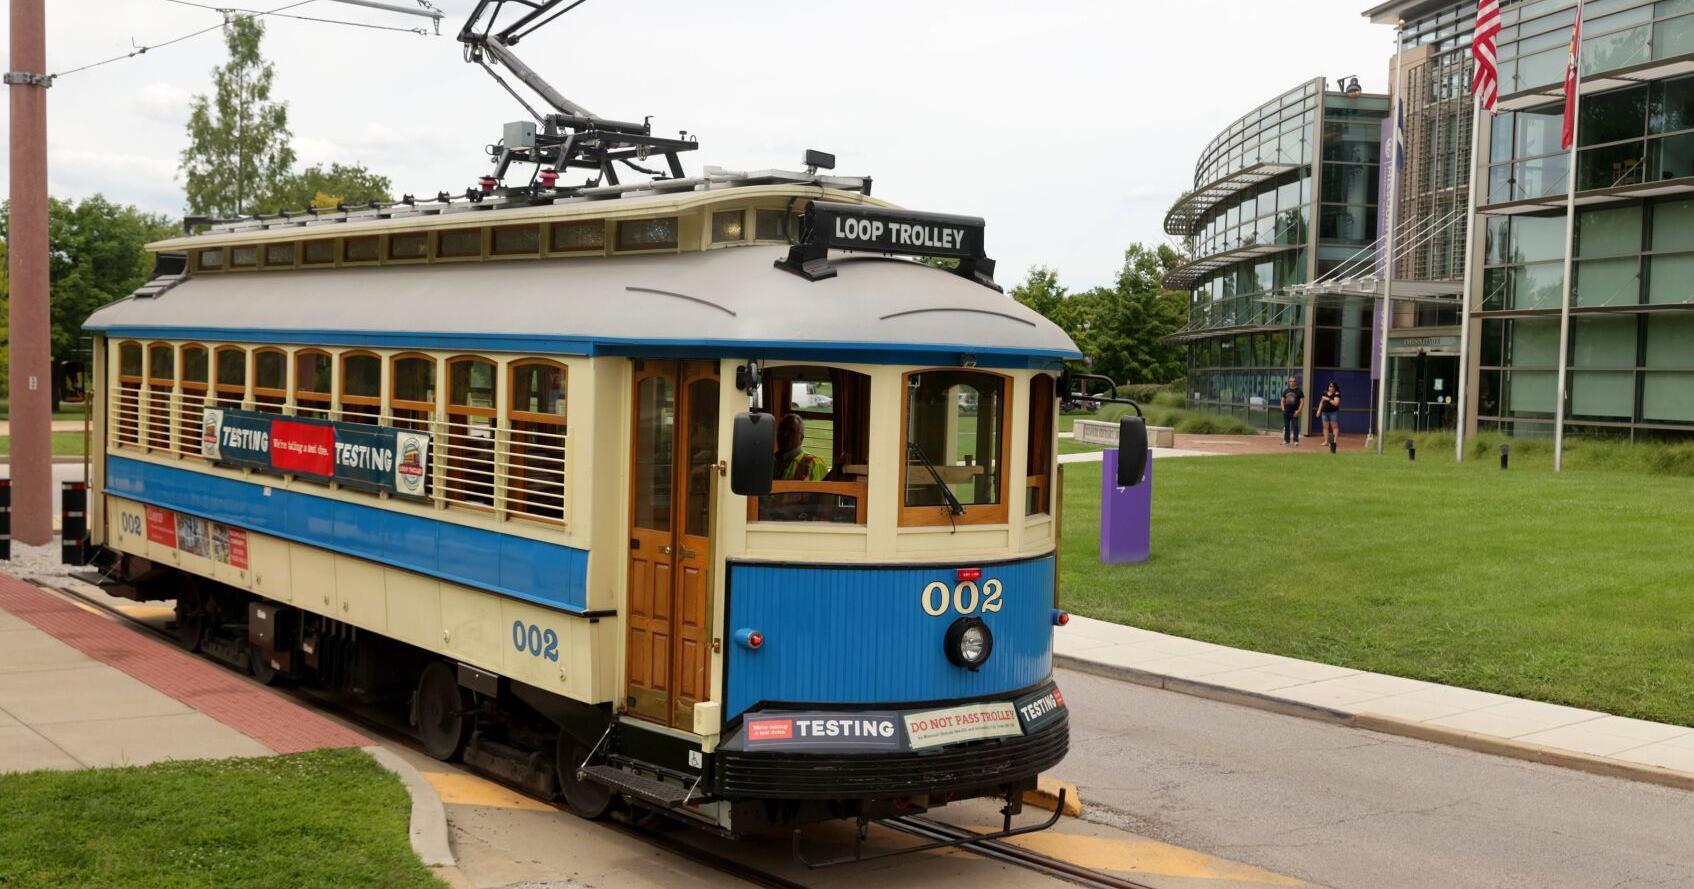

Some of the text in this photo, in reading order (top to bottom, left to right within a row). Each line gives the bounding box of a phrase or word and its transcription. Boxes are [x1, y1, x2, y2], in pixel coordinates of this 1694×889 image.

[835, 216, 965, 249] LOOP TROLLEY
[222, 426, 269, 452] TESTING
[335, 441, 393, 472] TESTING
[121, 511, 142, 537] 002
[921, 578, 1003, 616] 002
[512, 620, 559, 662] 002
[911, 720, 928, 733] DO
[929, 716, 953, 729] NOT
[955, 712, 980, 726] PASS
[980, 709, 1015, 722] TROLLEY
[1020, 693, 1057, 722] TESTING
[796, 719, 895, 738] TESTING
